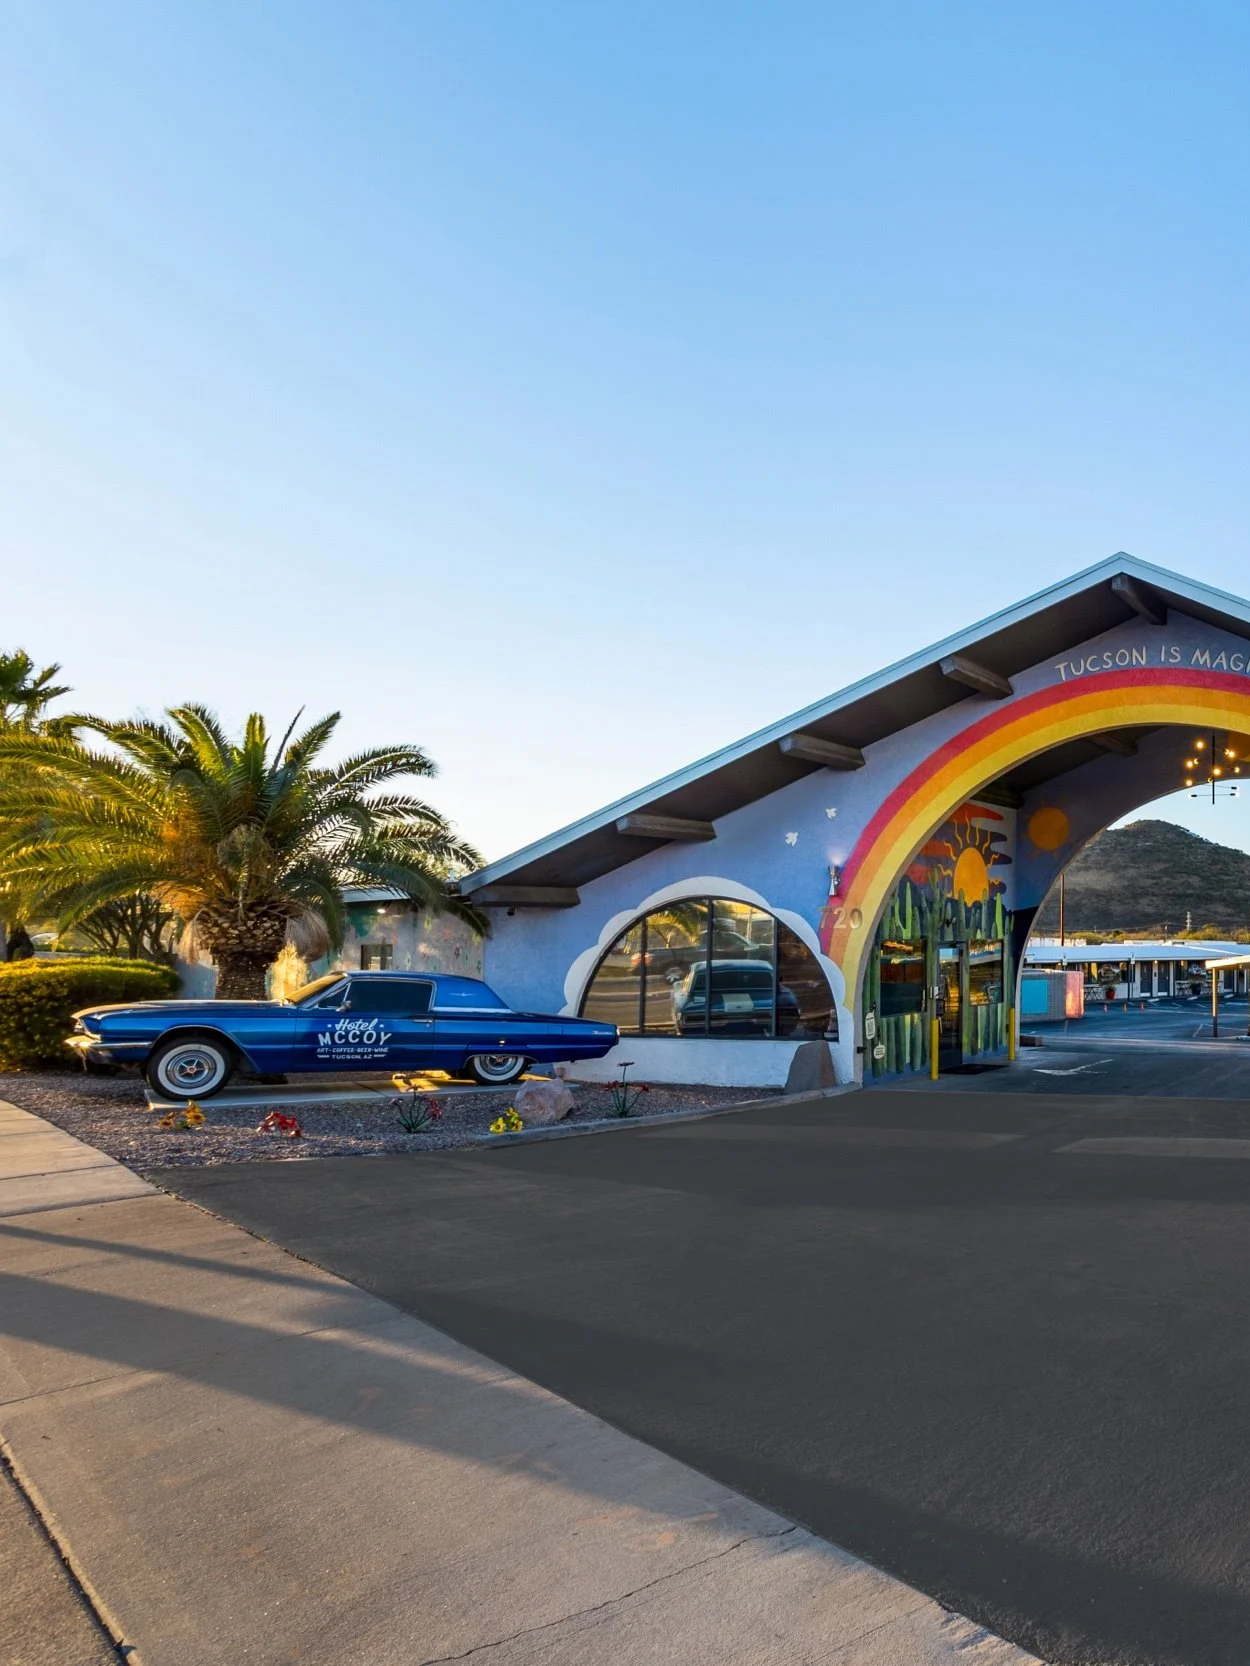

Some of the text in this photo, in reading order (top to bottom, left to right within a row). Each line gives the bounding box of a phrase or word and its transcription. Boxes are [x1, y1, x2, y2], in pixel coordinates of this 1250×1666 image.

[1055, 646, 1146, 681] TUCSON
[1160, 645, 1181, 663] IS
[818, 907, 863, 929] 720
[334, 1018, 379, 1031] Hotel
[318, 1030, 392, 1046] MCCOY
